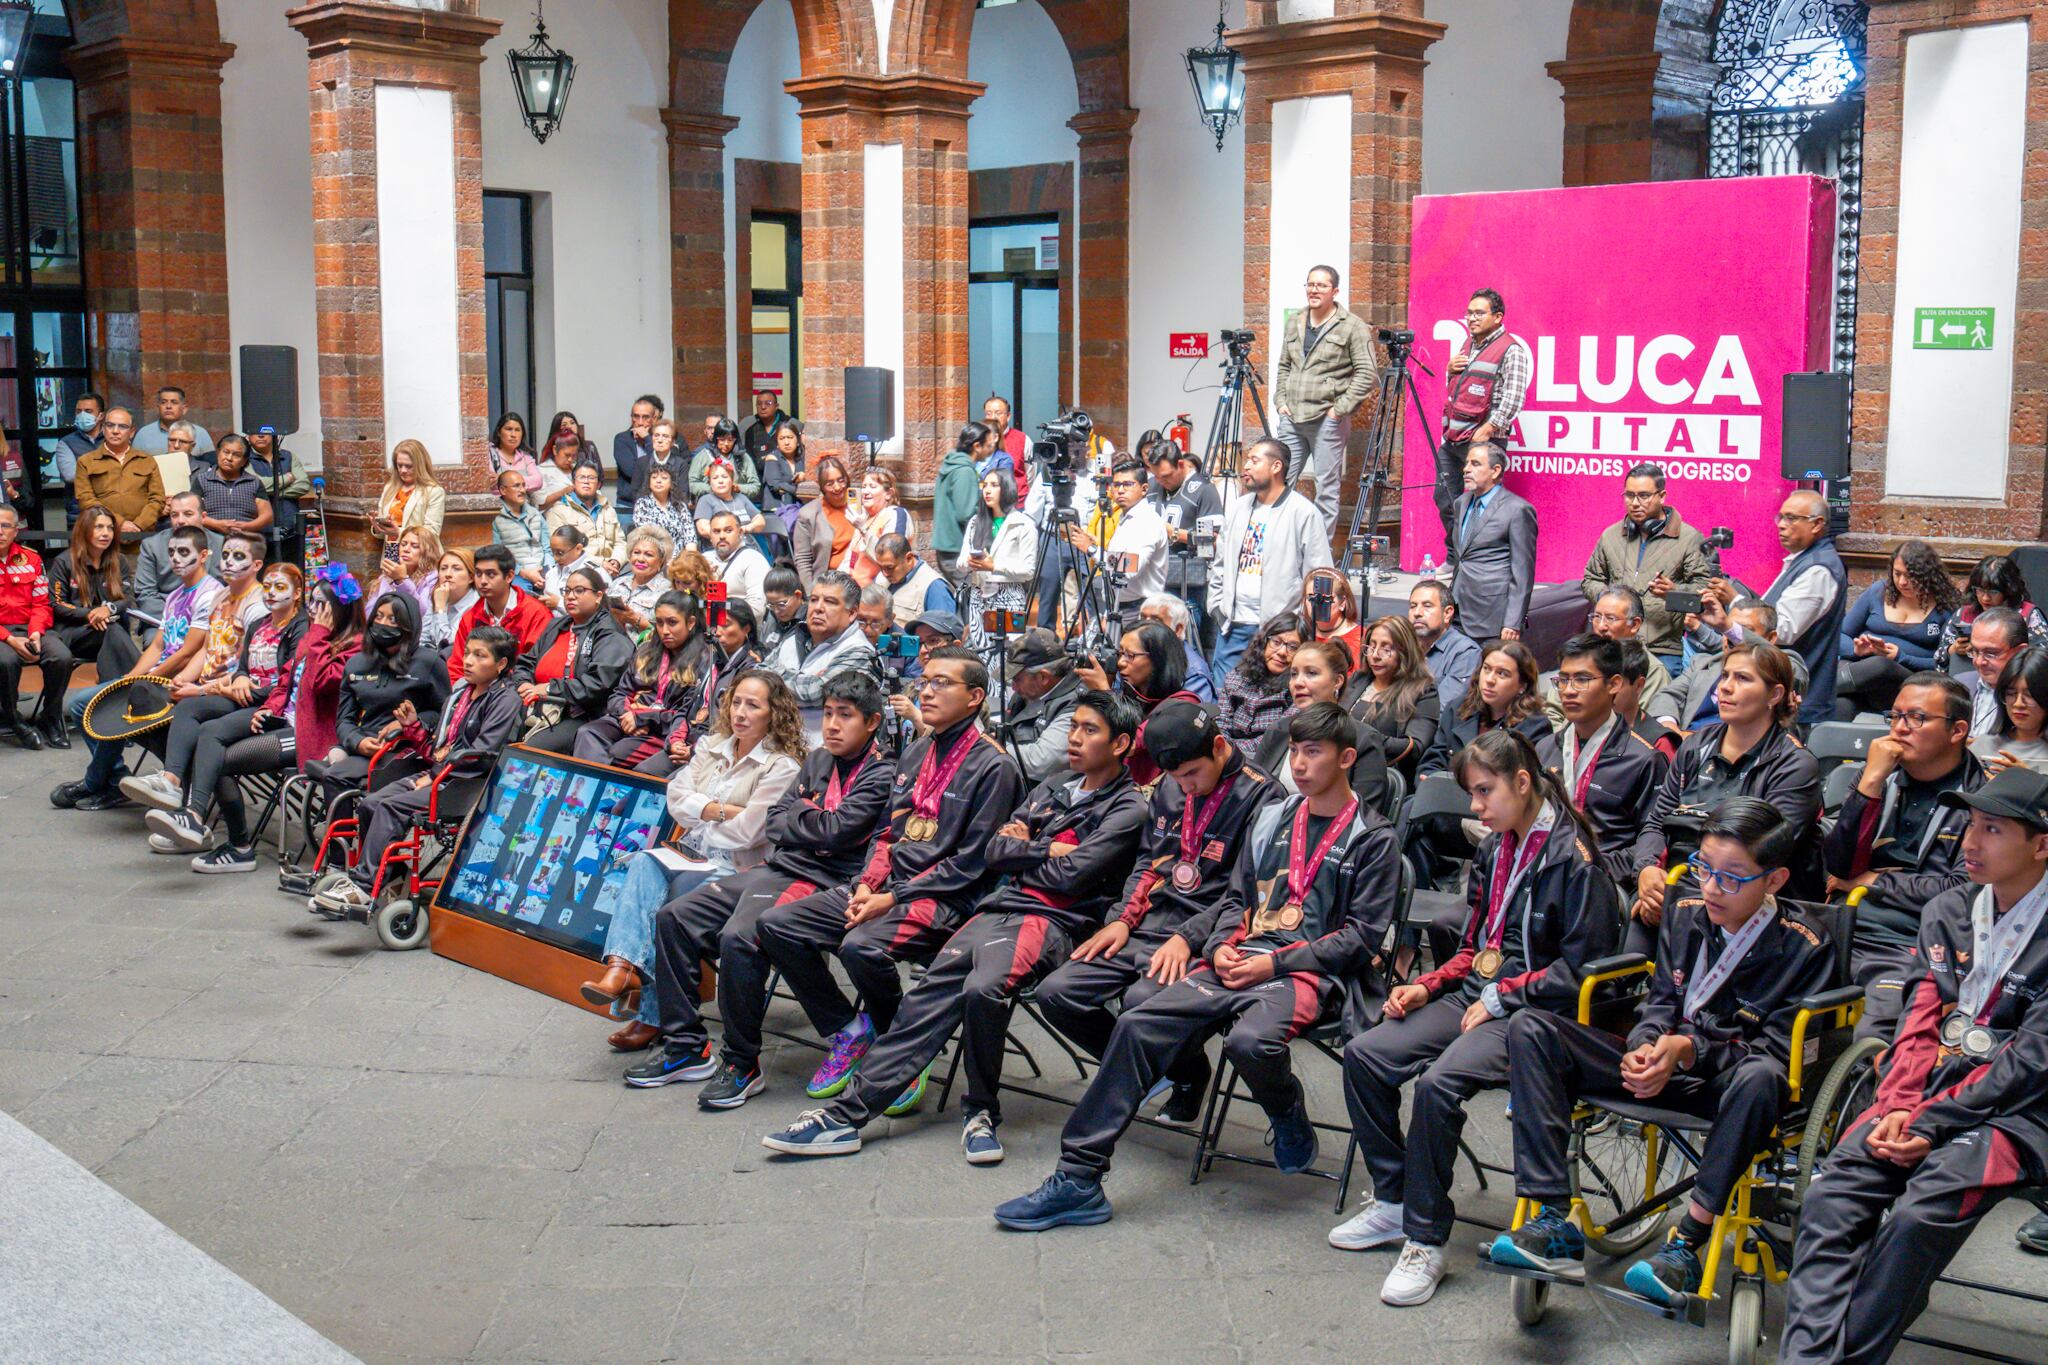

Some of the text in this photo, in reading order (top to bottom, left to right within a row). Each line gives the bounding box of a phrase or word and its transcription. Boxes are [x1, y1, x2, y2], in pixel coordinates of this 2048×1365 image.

[1173, 347, 1205, 356] SALIDA
[1508, 415, 1739, 455] APITAL
[1644, 460, 1752, 482] ROGRESO
